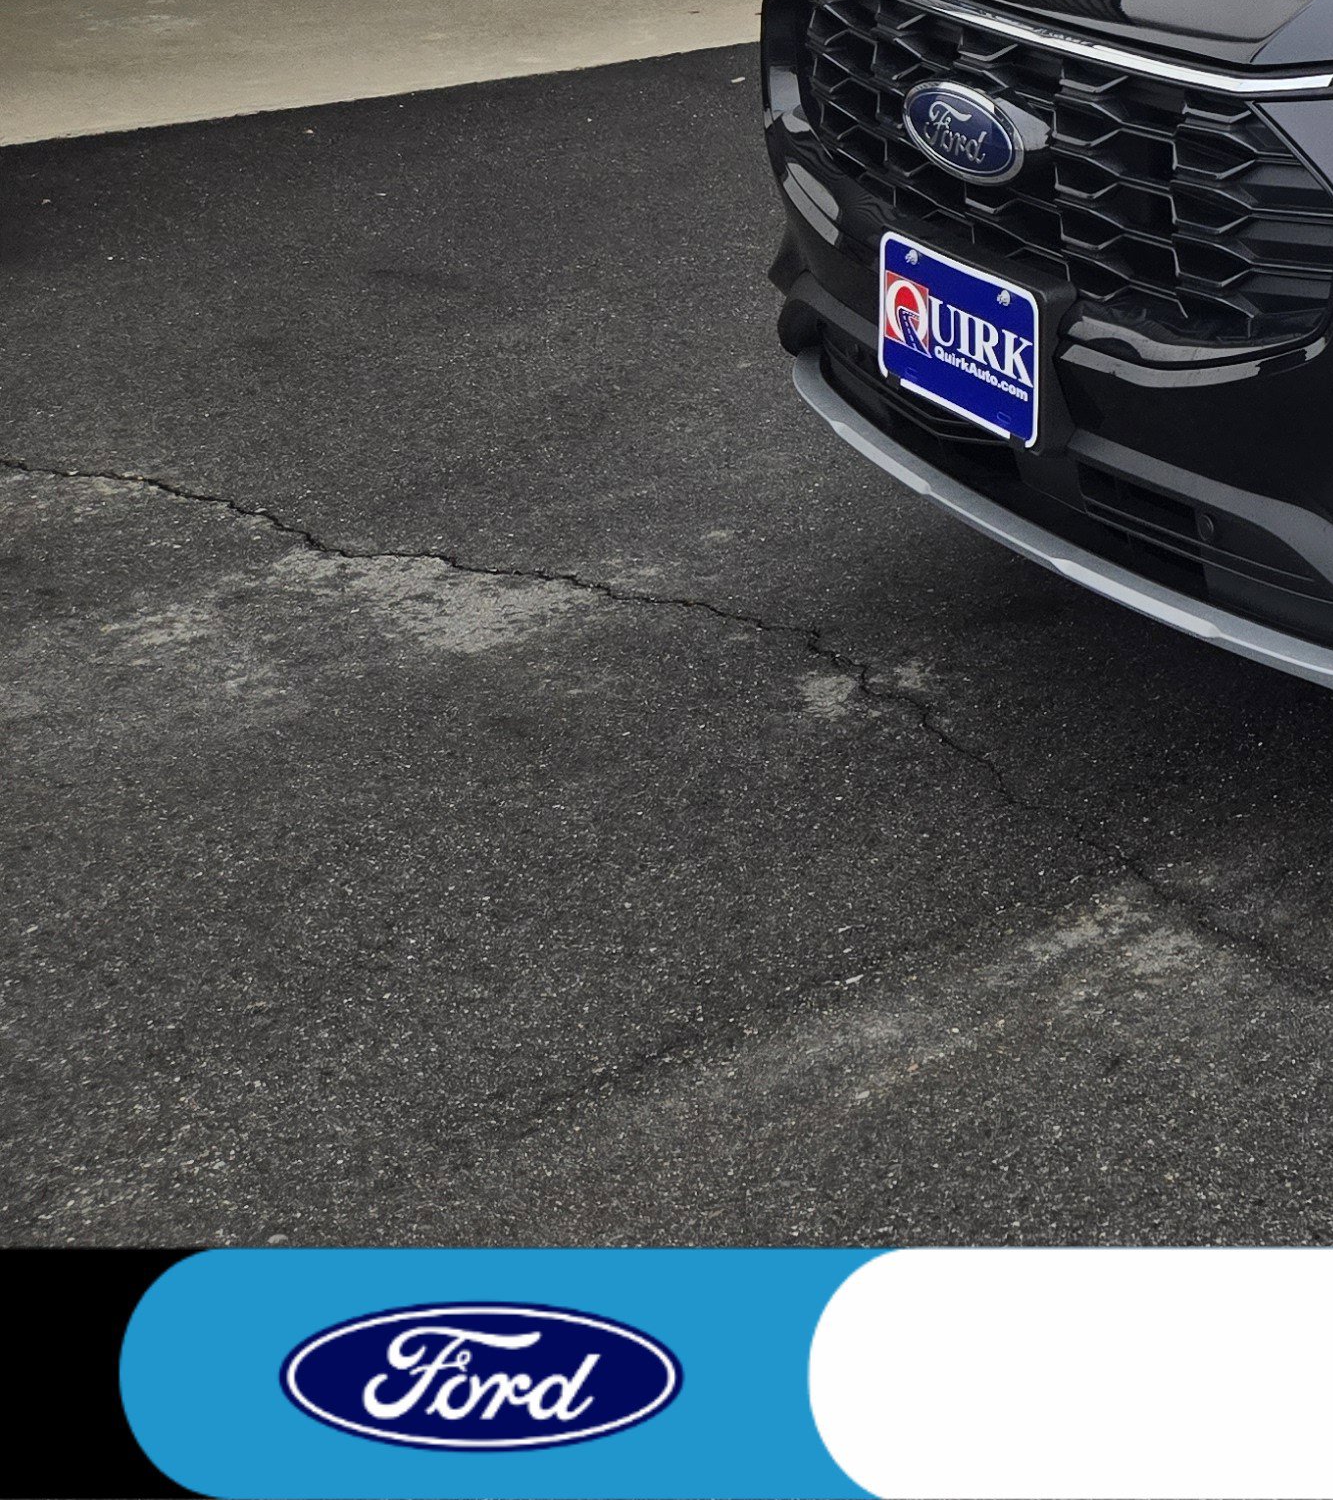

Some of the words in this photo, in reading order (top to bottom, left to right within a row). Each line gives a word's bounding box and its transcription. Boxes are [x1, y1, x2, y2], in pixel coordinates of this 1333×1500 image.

[923, 100, 988, 164] Ford
[885, 280, 1034, 388] QUIRK
[934, 346, 1029, 402] QuirkAuto.com
